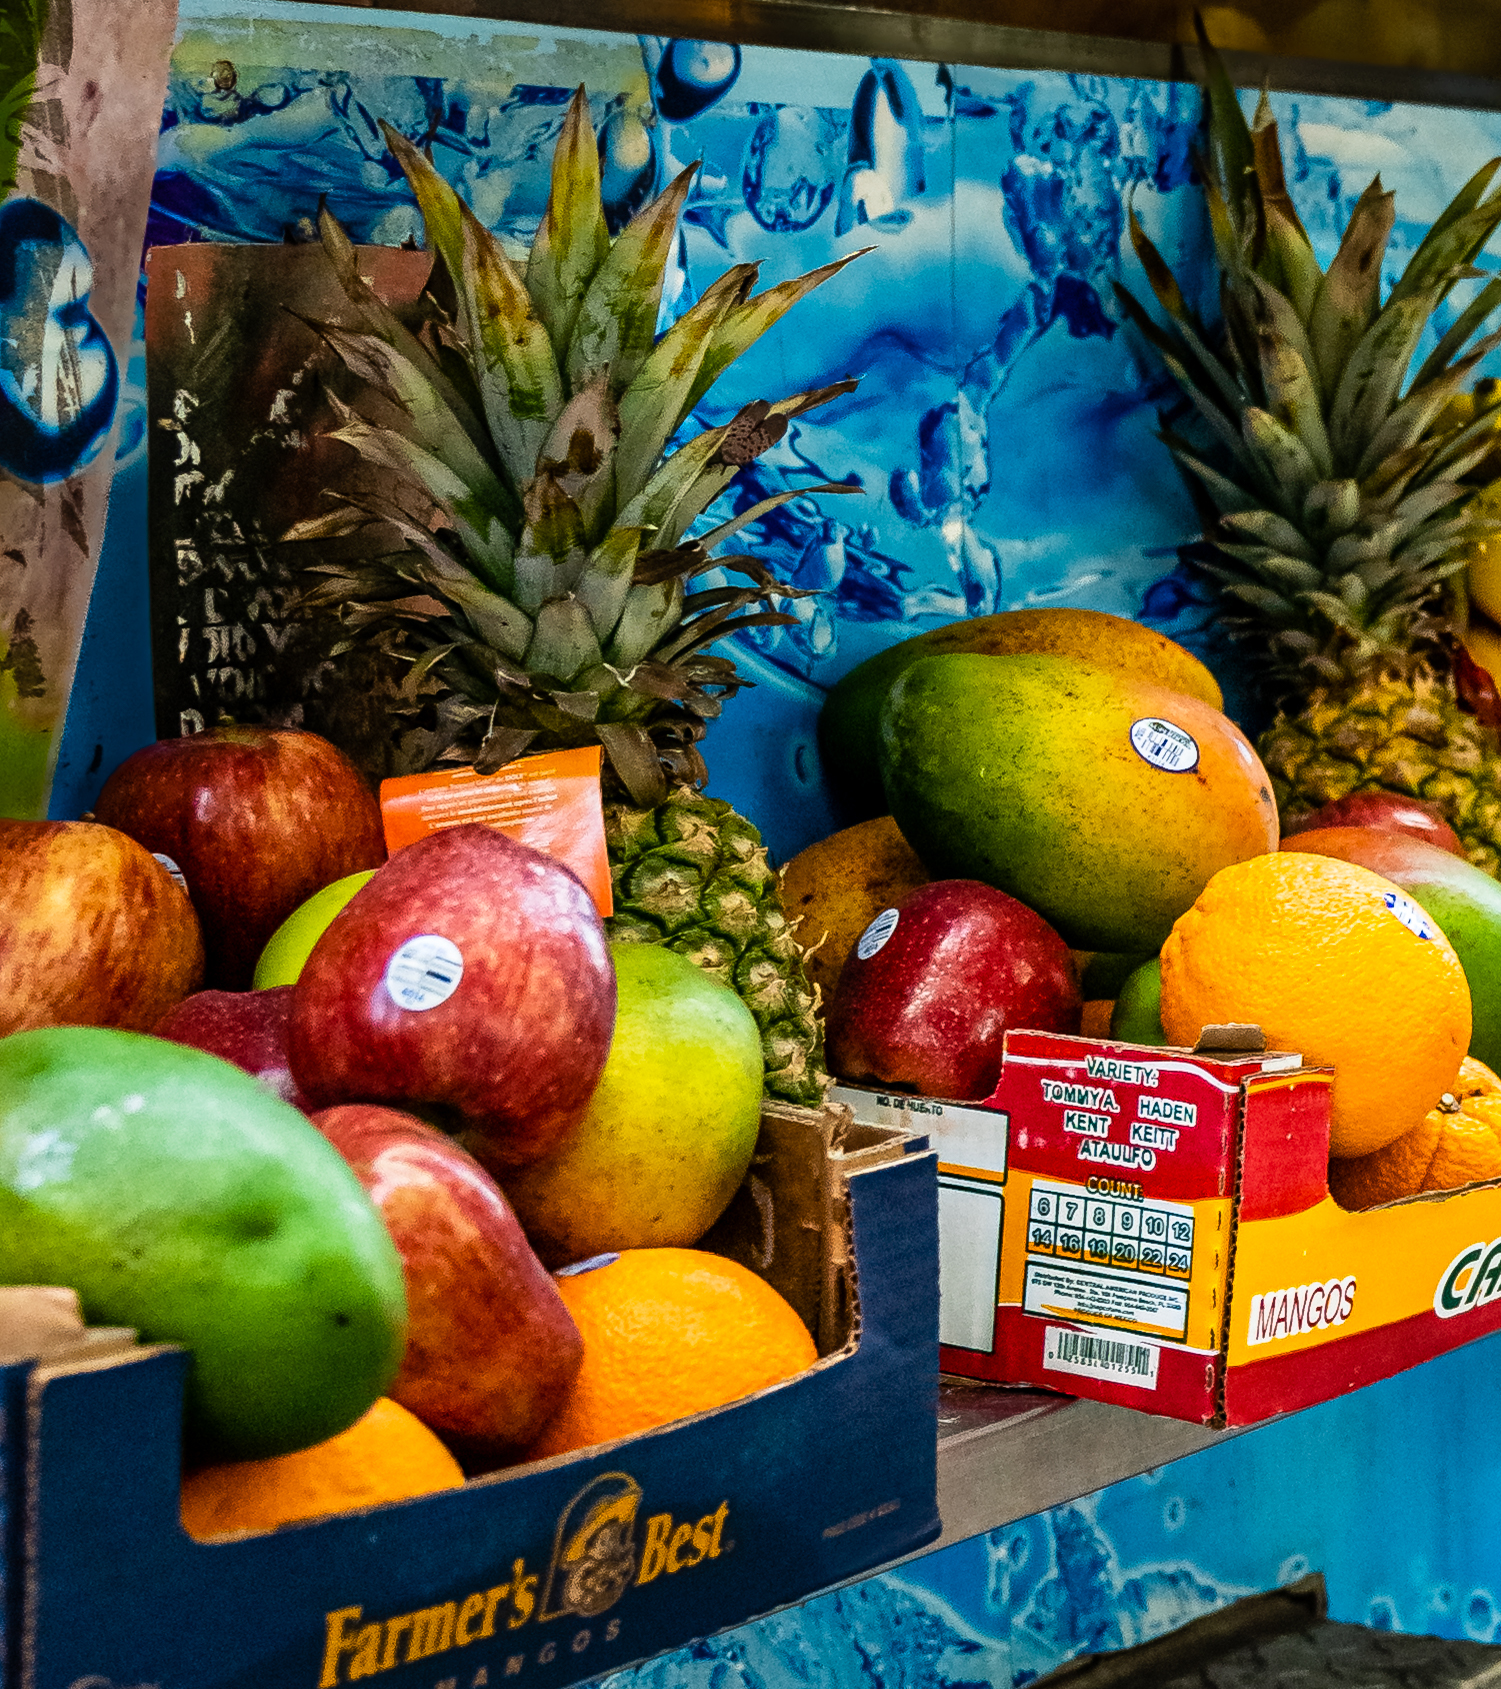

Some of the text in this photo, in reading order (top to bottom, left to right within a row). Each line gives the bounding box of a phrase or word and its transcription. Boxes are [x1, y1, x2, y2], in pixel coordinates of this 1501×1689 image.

[1086, 1057, 1157, 1086] VARIETY:
[1065, 1111, 1176, 1147] KENT KEITT
[1139, 1099, 1194, 1124] HADEN
[1080, 1140, 1153, 1166] ATAULFO
[1037, 1197, 1191, 1242] 6 7 8 9 10 12
[1032, 1228, 1189, 1273] 14 16 18 20 22 24
[1255, 1280, 1357, 1341] MANGOS
[317, 1500, 730, 1689] Farmer's Best
